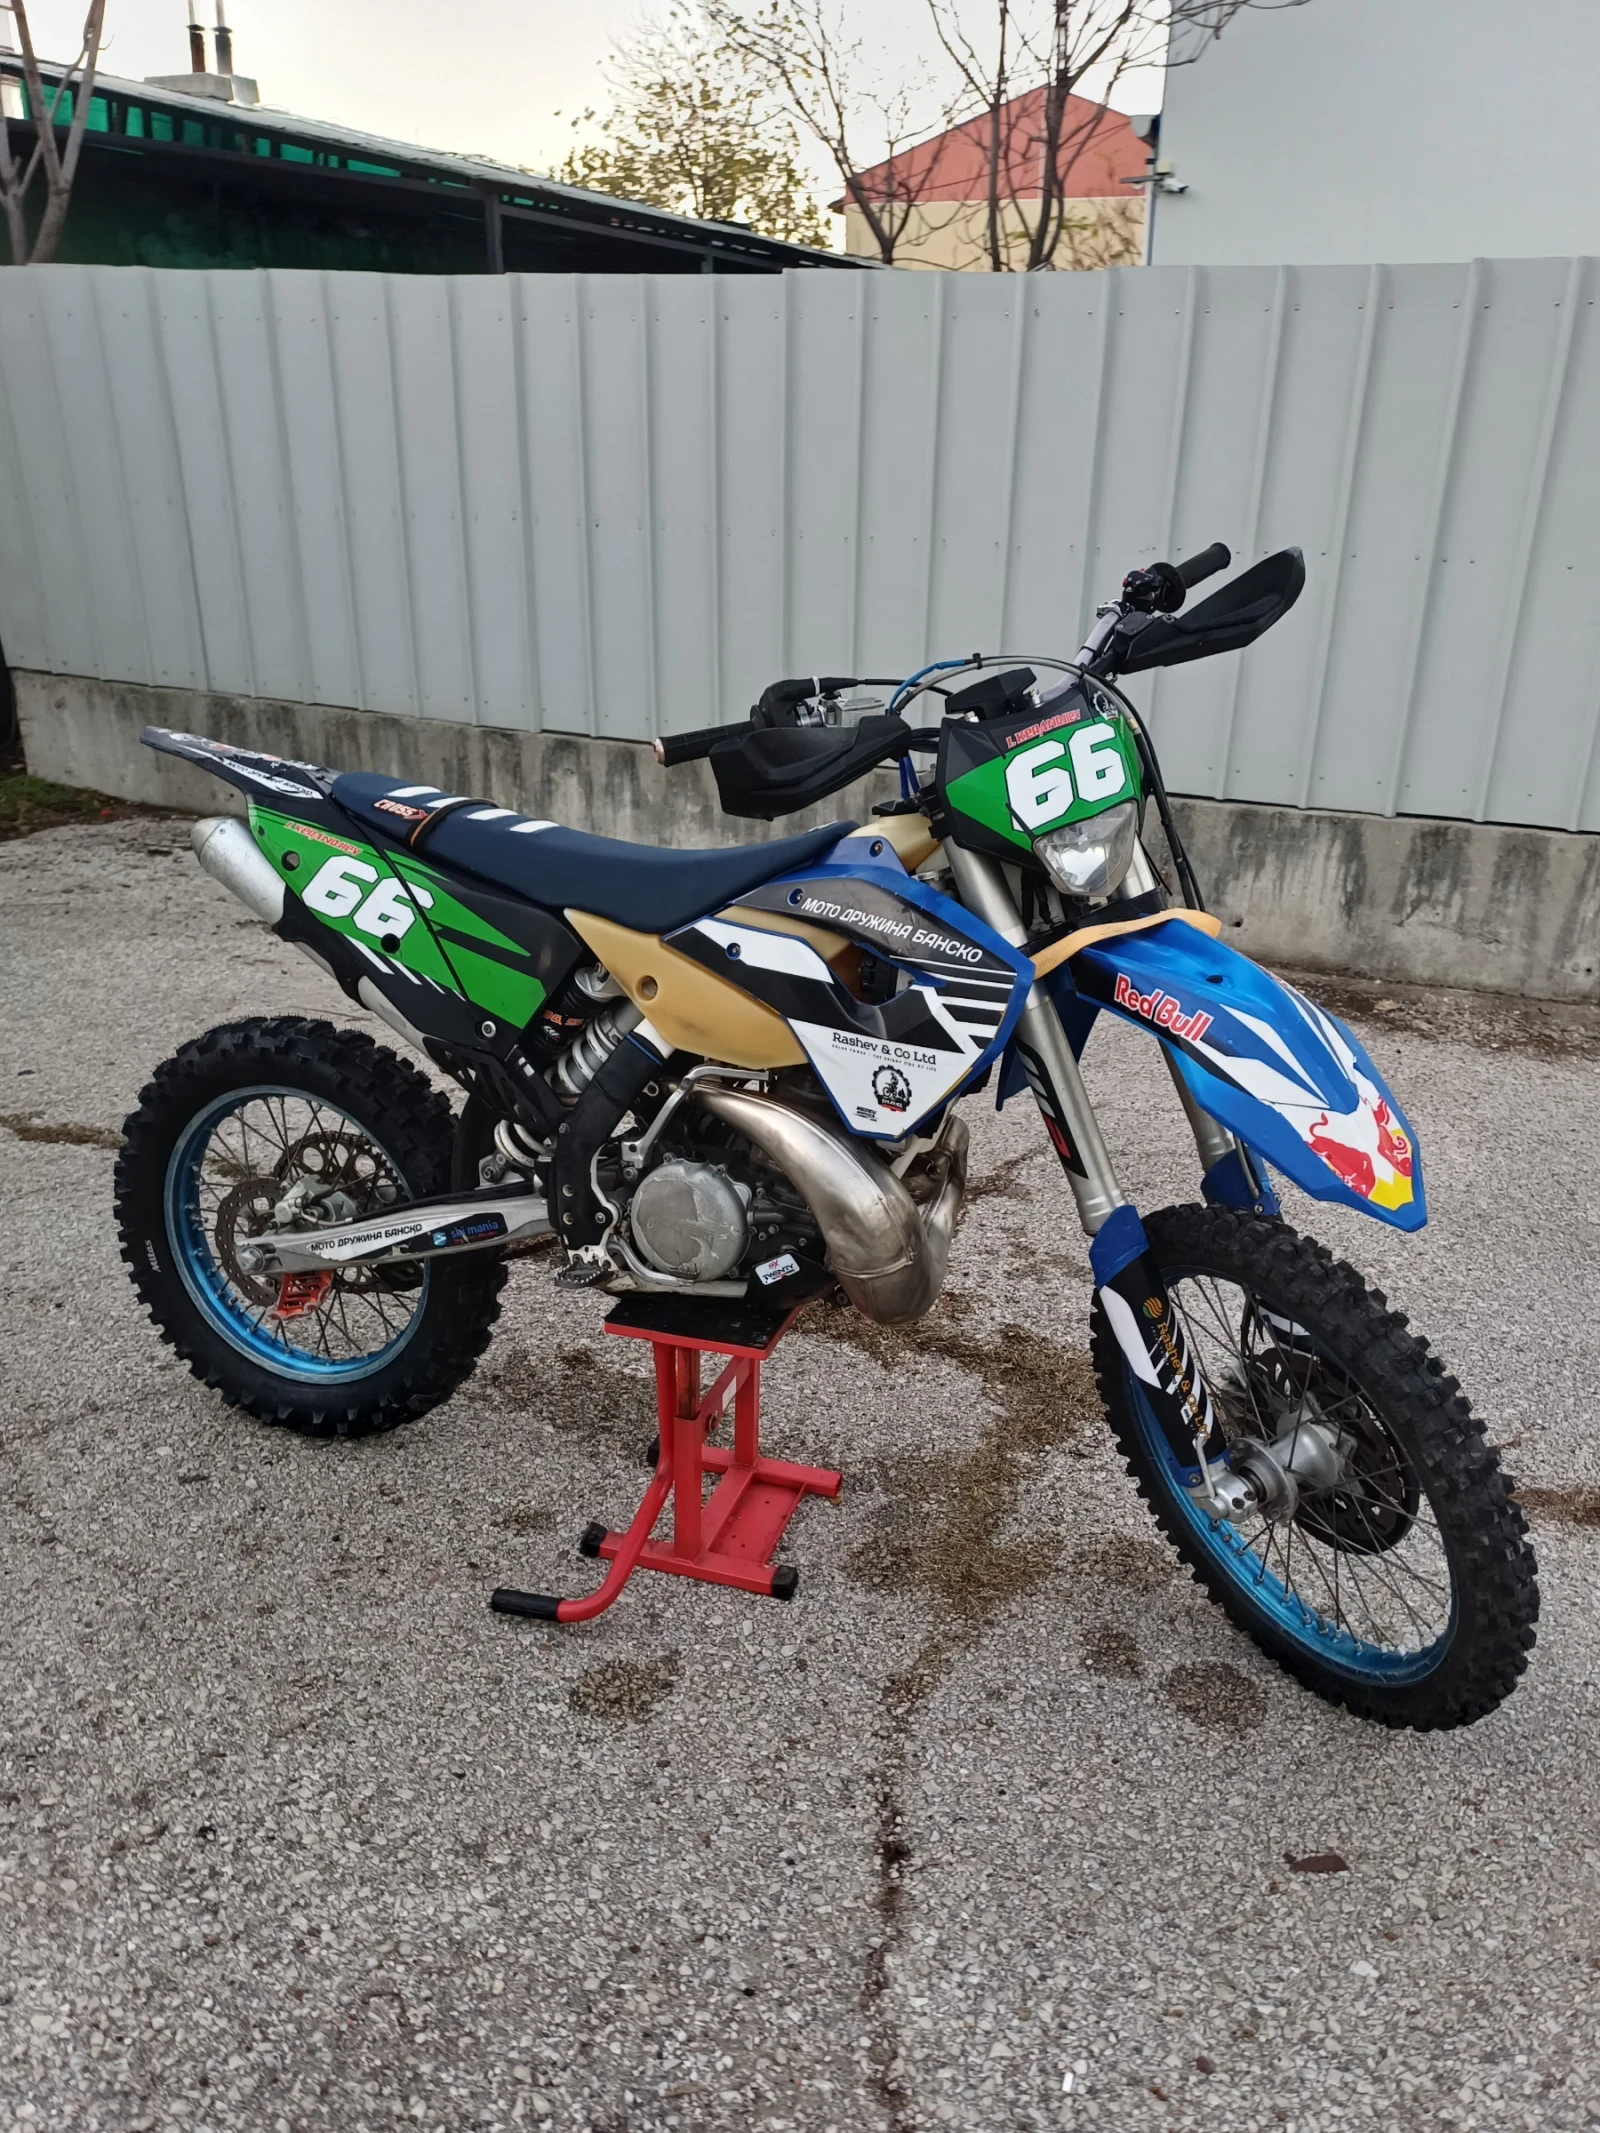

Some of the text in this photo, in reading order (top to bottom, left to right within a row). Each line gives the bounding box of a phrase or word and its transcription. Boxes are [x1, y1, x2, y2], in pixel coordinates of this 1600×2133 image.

[1004, 721, 1126, 834] 66
[300, 854, 435, 940] 66
[801, 898, 983, 963] МОТО ДРУЖИНА БАНСКО
[1114, 972, 1214, 1042] Red Bull
[832, 1032, 937, 1065] Rashev & Co Ltd
[311, 1223, 422, 1252] МОТО ДРУЖИНА БАНСКО
[466, 1222, 499, 1236] mania
[1157, 1321, 1186, 1376] Rashev
[1180, 1379, 1191, 1393] &
